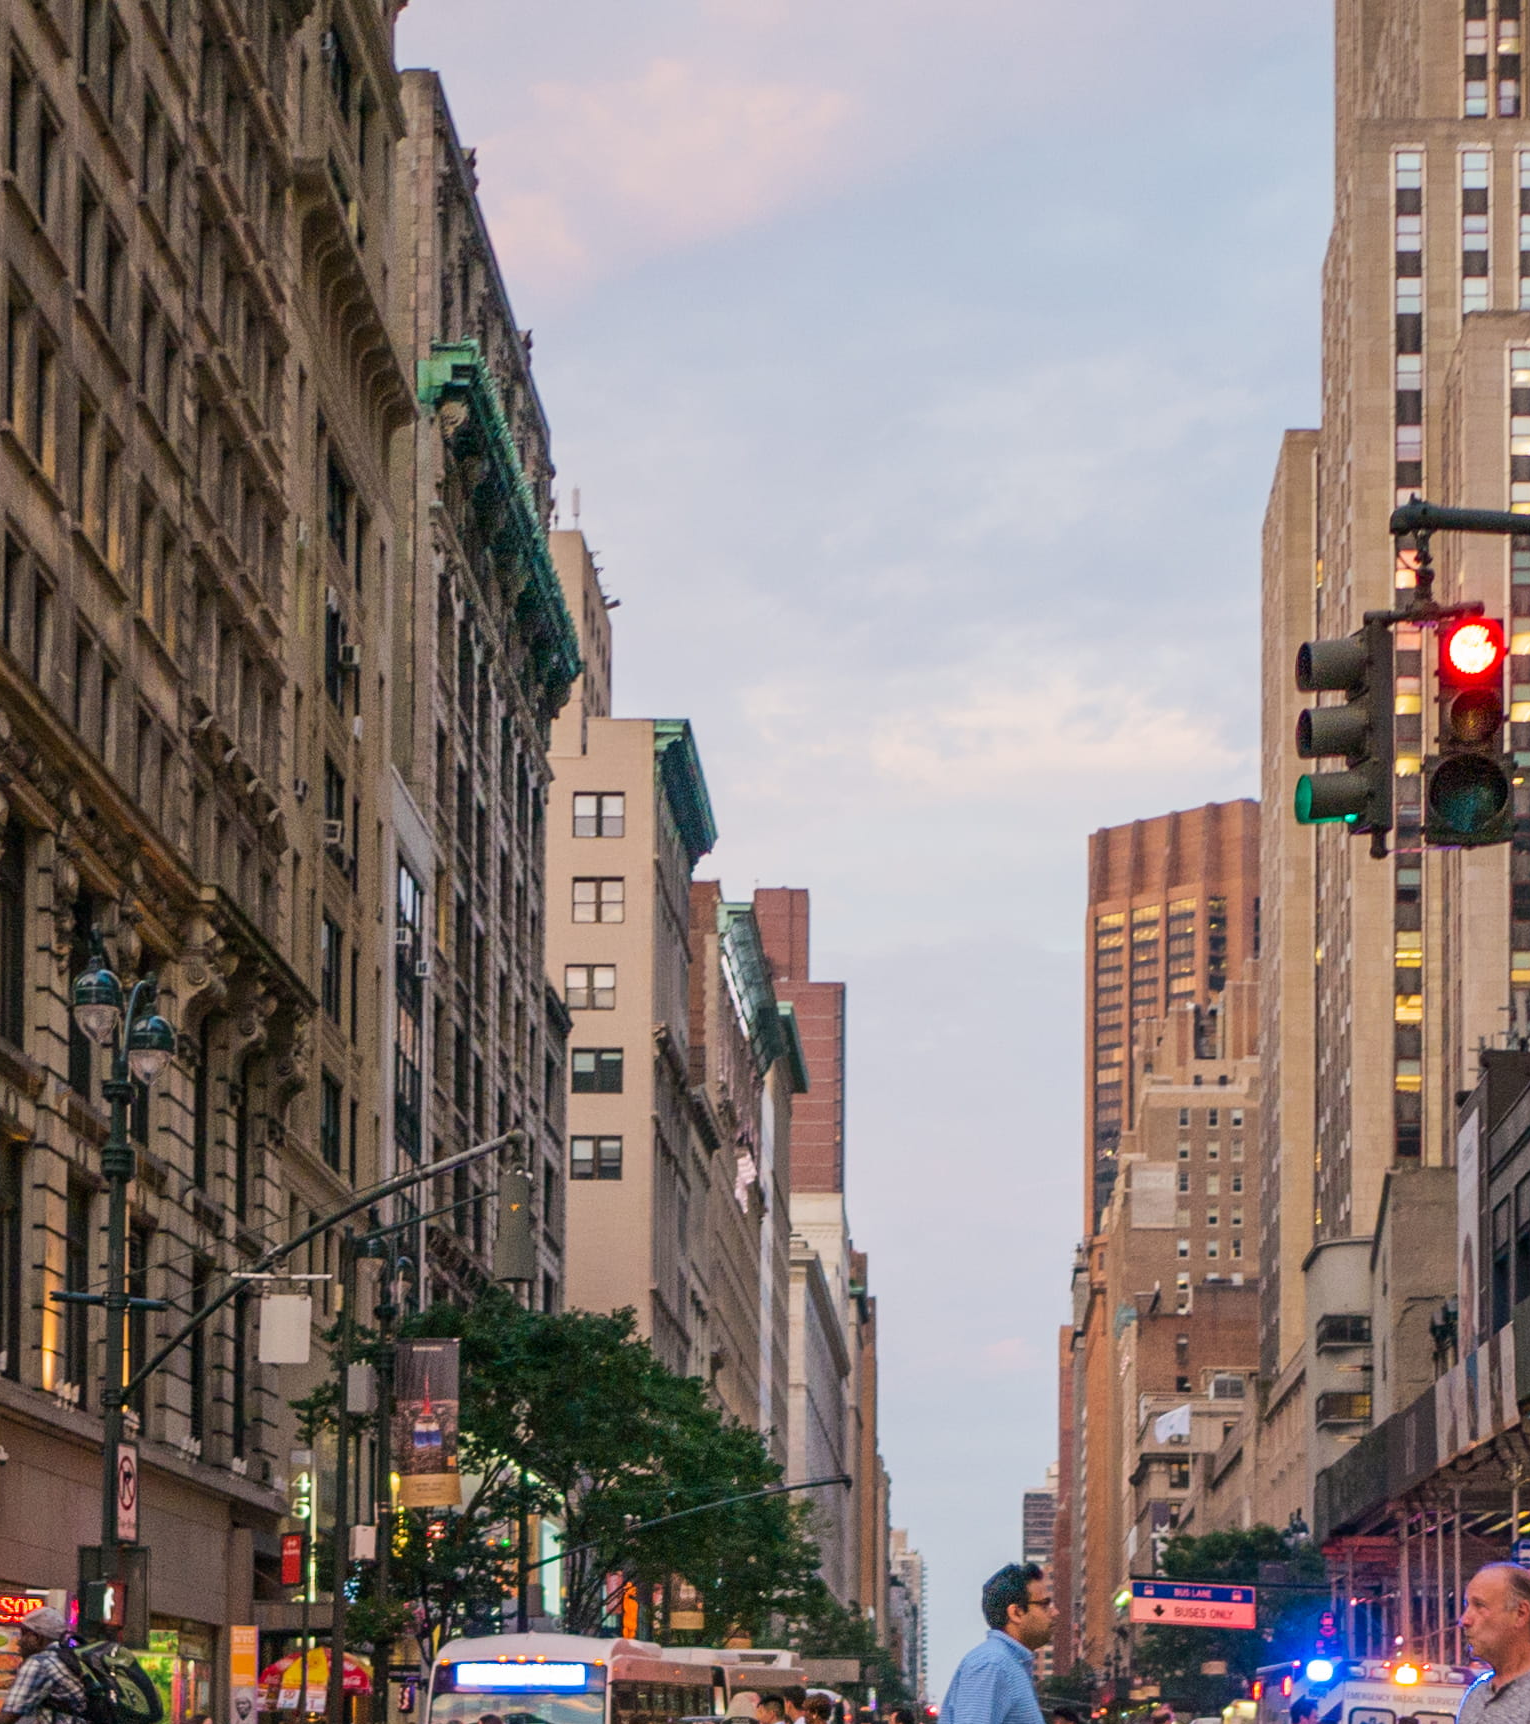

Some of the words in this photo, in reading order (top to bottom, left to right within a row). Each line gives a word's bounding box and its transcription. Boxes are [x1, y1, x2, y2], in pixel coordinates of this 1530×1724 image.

[1173, 1588, 1191, 1598] BUS
[1192, 1589, 1213, 1599] LANE
[1174, 1607, 1207, 1619] BUSES
[1209, 1608, 1235, 1620] ONLY
